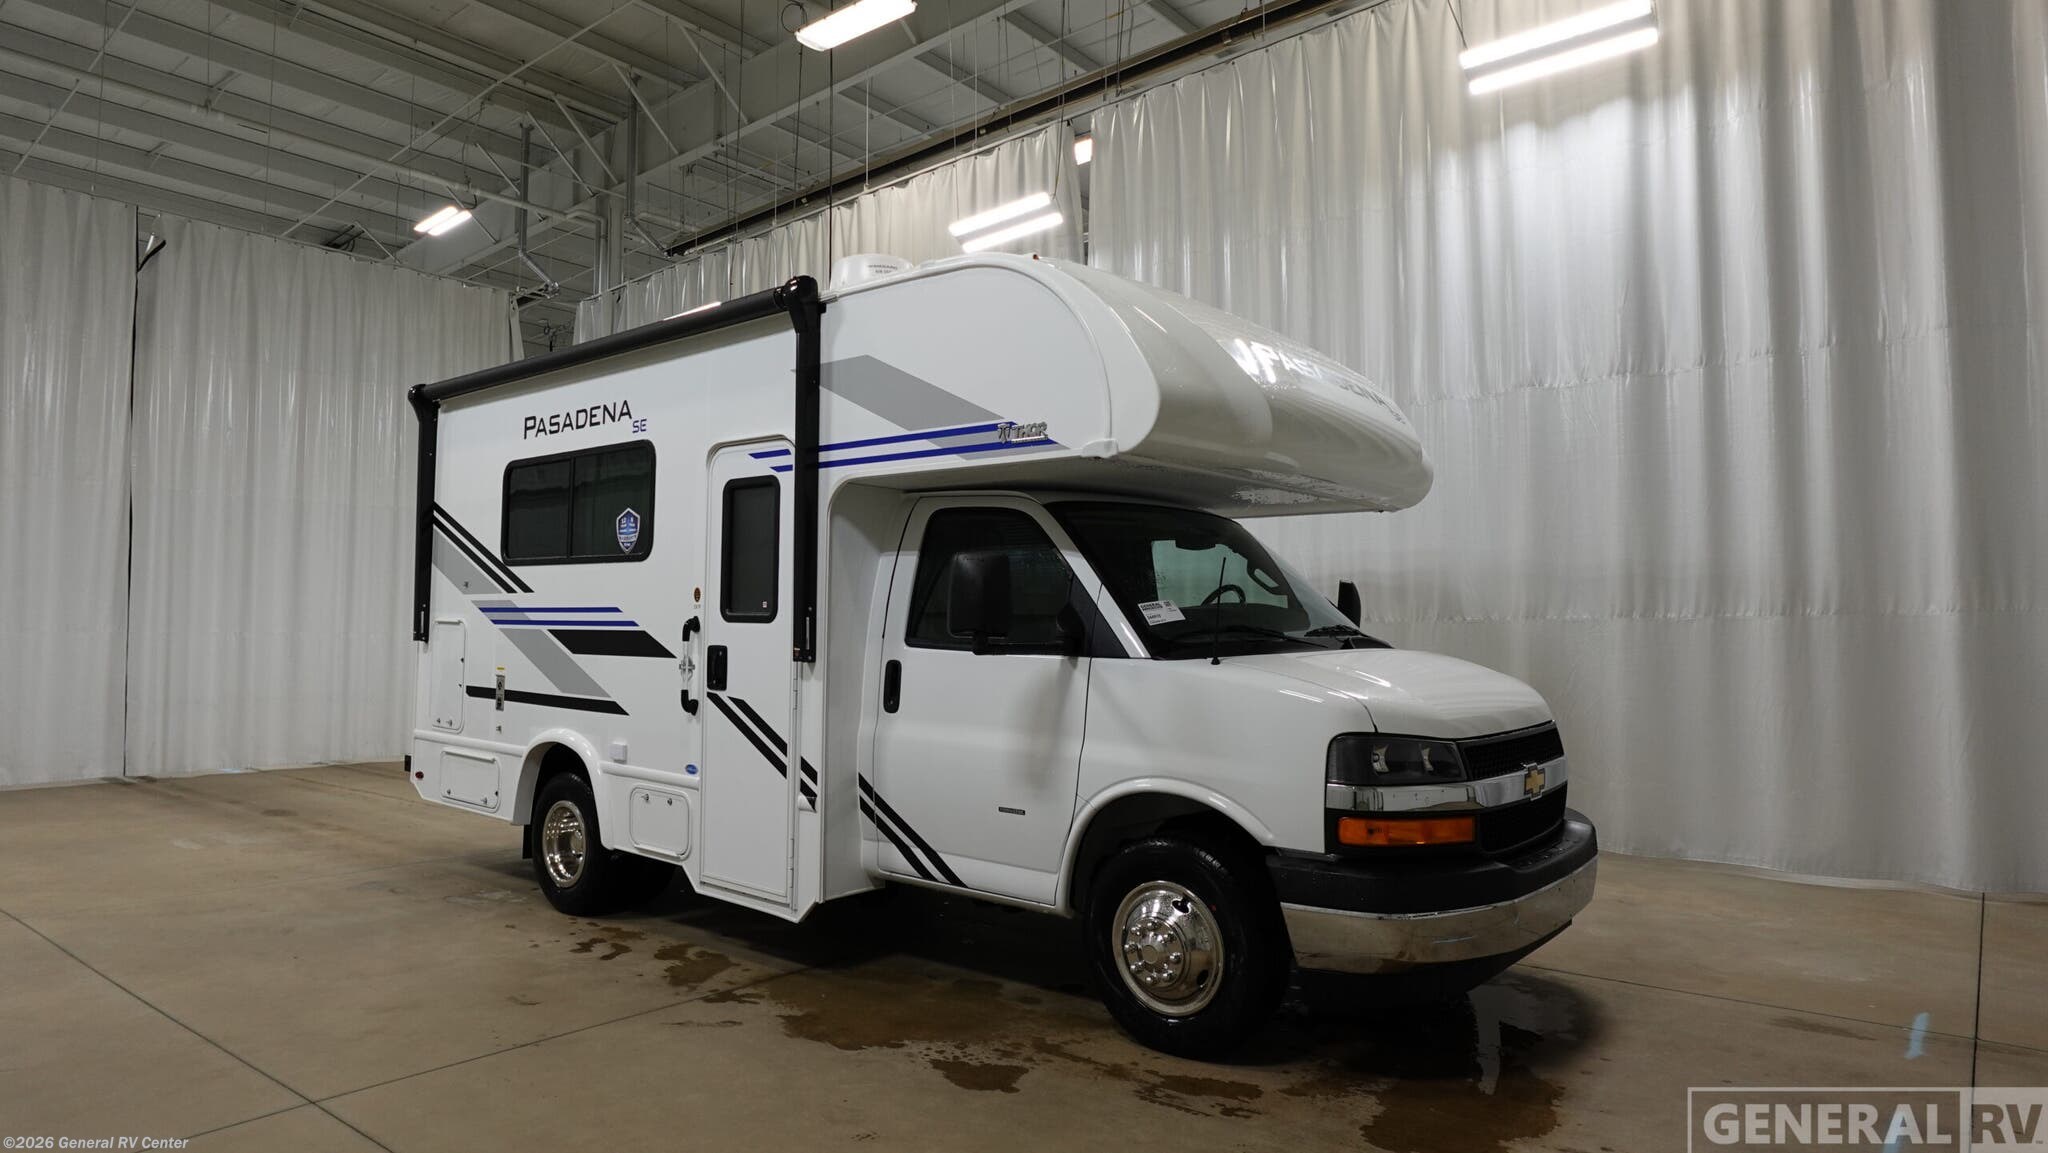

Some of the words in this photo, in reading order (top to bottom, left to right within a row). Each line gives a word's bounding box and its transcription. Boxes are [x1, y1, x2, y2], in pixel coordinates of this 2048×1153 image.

[524, 400, 632, 440] PASADENA
[632, 419, 647, 434] SE
[1011, 421, 1048, 440] THOR
